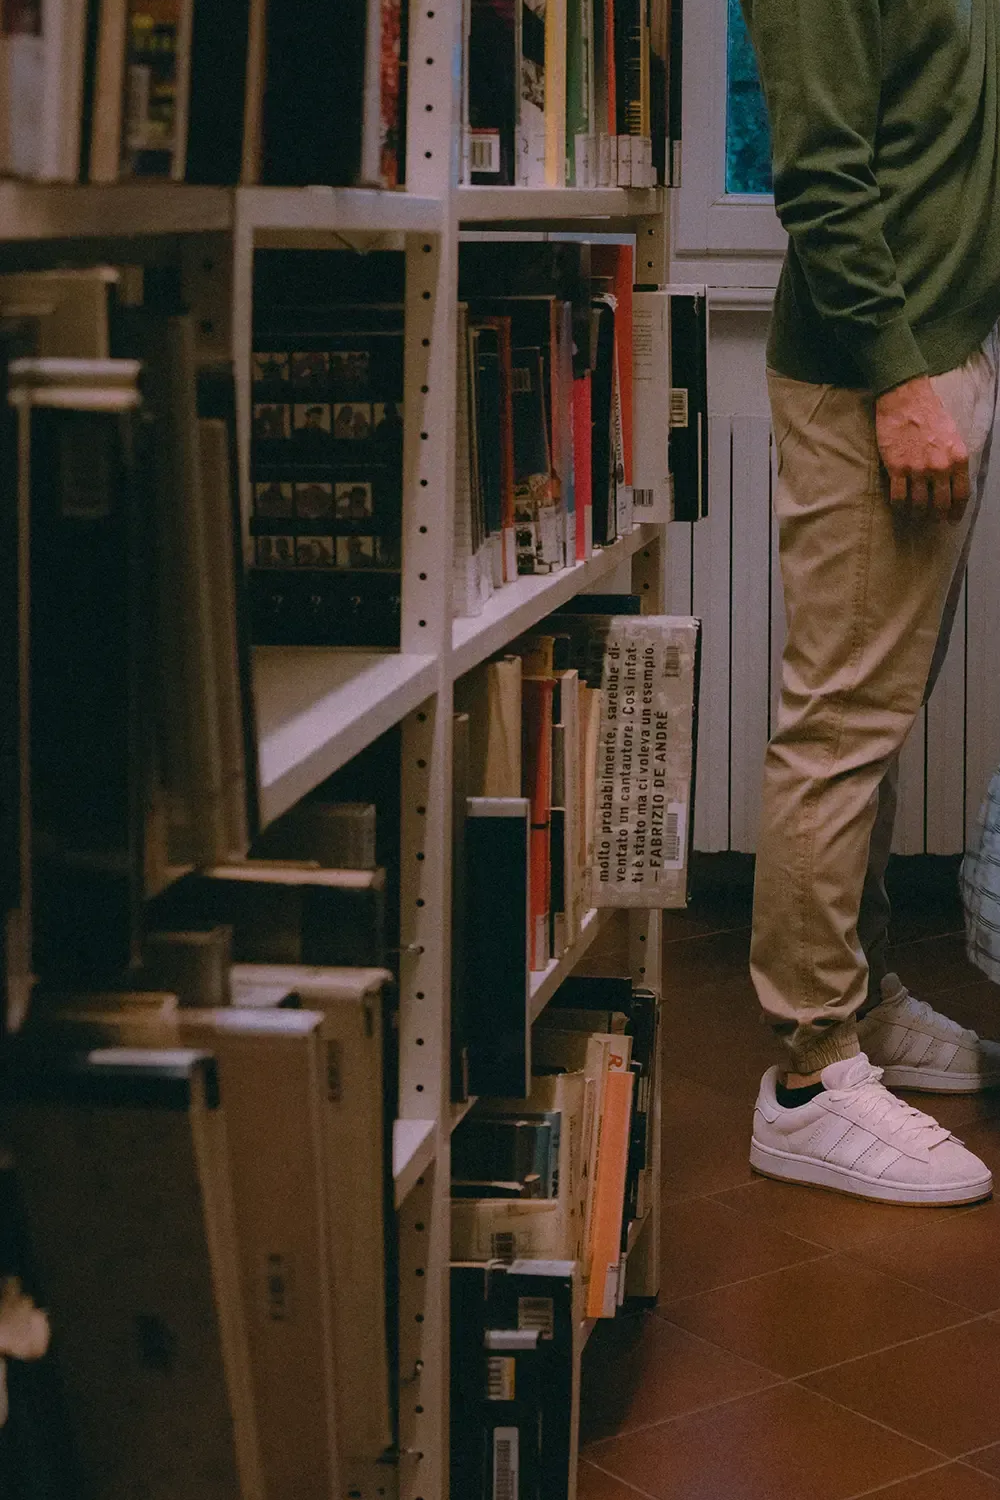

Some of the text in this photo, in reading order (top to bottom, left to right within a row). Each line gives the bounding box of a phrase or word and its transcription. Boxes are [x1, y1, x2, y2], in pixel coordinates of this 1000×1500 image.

[624, 640, 637, 682] infat-
[643, 642, 657, 705] esempio.
[643, 709, 651, 726] un
[655, 710, 669, 763] ANDRÉ
[600, 640, 621, 883] molto probabilmente, sarebbe di-
[621, 719, 634, 800] cantautore.
[640, 728, 650, 775] voleva
[639, 778, 648, 791] ci
[653, 767, 666, 786] DE
[620, 806, 629, 823] un
[639, 799, 648, 817] ma
[616, 828, 629, 883] ventato
[634, 819, 647, 857] stato
[632, 870, 643, 884] ti
